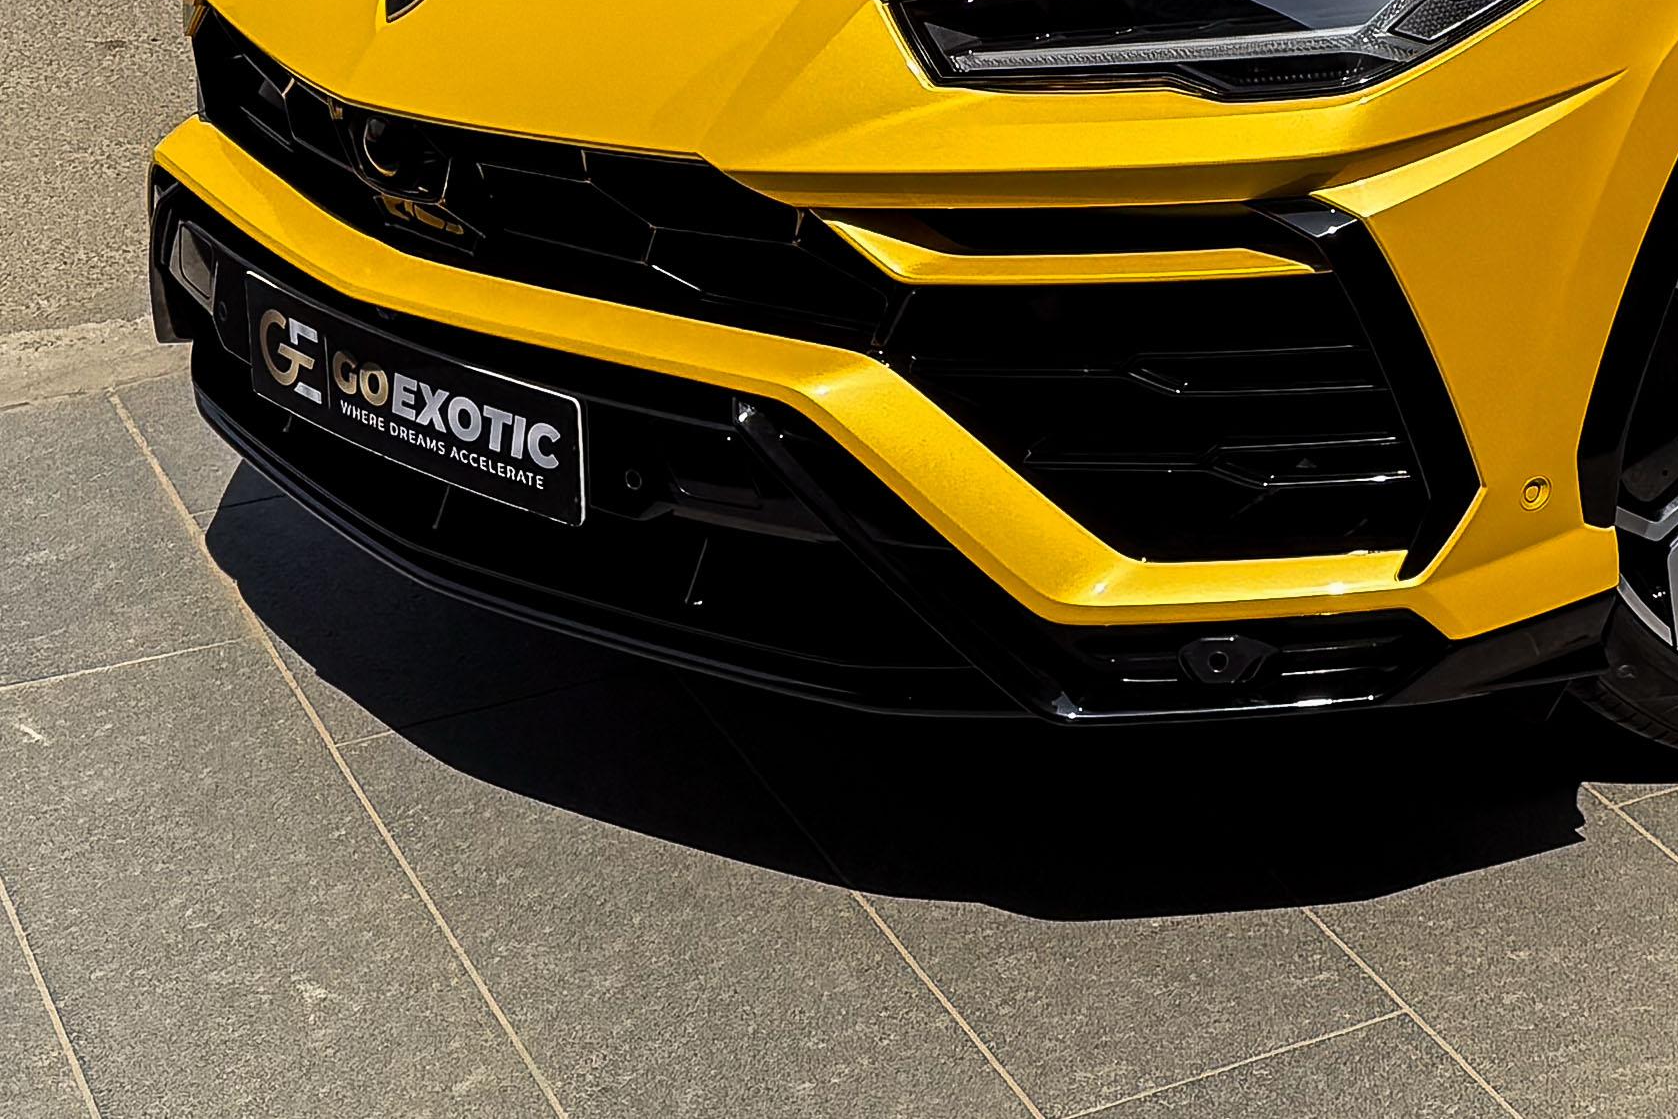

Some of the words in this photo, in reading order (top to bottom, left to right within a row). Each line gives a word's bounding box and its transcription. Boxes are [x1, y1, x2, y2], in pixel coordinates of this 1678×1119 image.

[340, 399, 385, 431] WHERE
[390, 422, 445, 455] DREAMS
[450, 447, 544, 490] ACCELERATE
